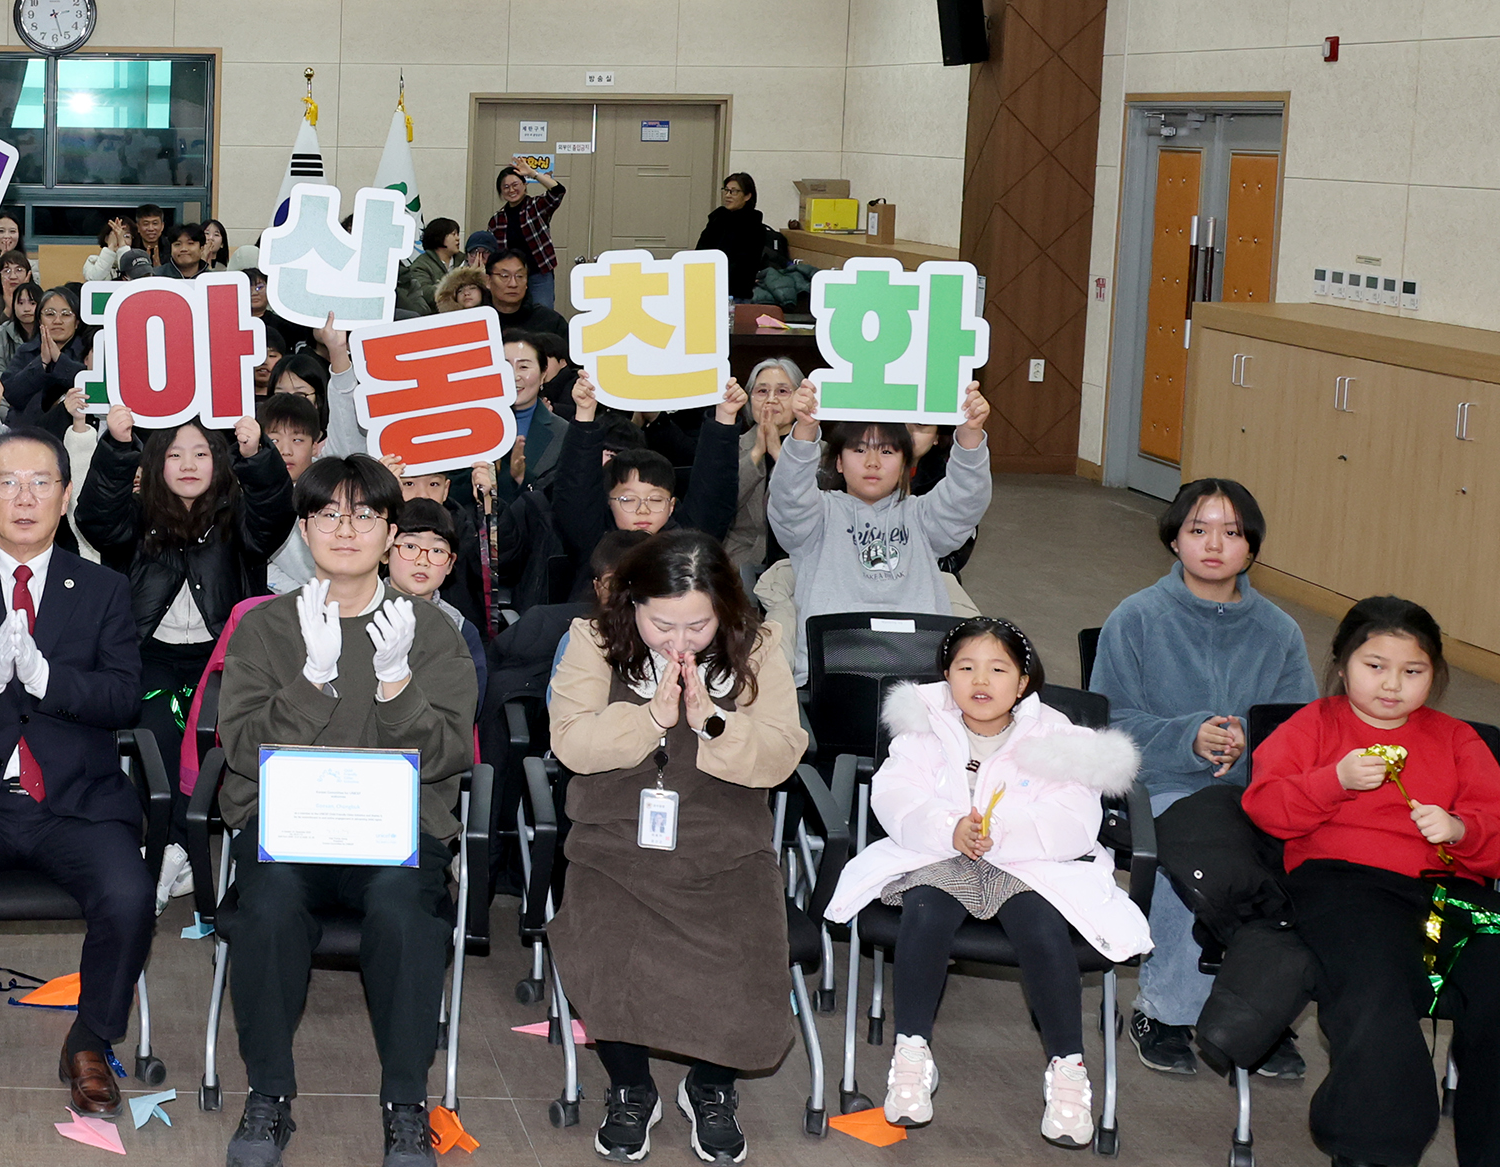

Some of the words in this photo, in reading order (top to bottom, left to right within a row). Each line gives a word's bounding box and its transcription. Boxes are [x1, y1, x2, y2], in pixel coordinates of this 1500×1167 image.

[28, 10, 35, 19] 9
[76, 10, 83, 18] 3
[31, 22, 38, 31] 8
[72, 22, 79, 30] 4
[40, 32, 47, 40] 7
[52, 34, 58, 42] 6
[64, 31, 71, 39] 5
[269, 194, 405, 320] 산
[582, 262, 718, 400] 친
[820, 270, 976, 413] 화
[116, 283, 255, 418] 아
[362, 319, 510, 466] 동
